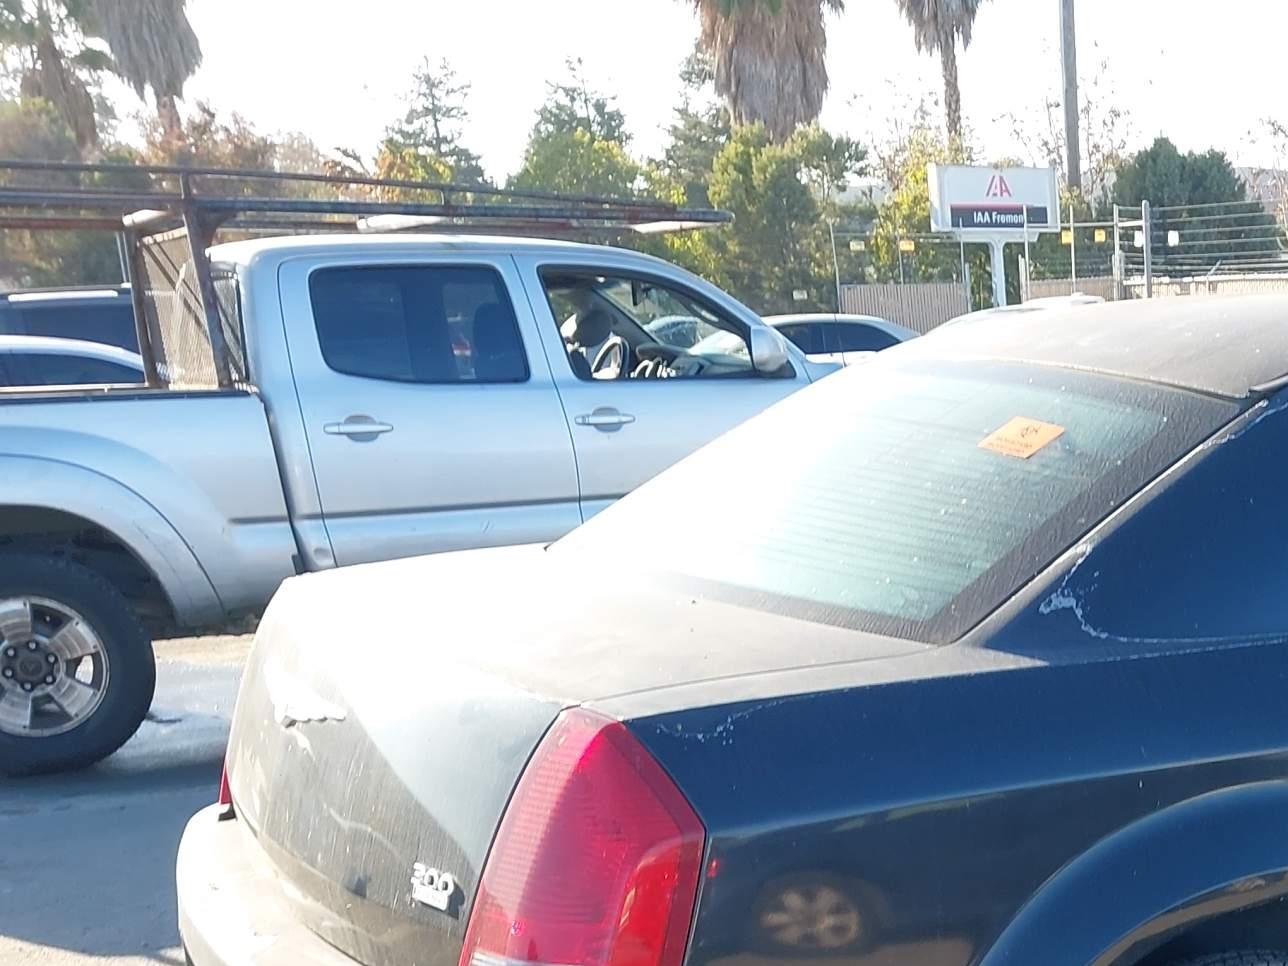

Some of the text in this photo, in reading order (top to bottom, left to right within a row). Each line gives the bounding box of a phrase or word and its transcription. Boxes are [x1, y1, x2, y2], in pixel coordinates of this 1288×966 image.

[973, 211, 1025, 224] IAA Fremon
[411, 862, 454, 896] 300
